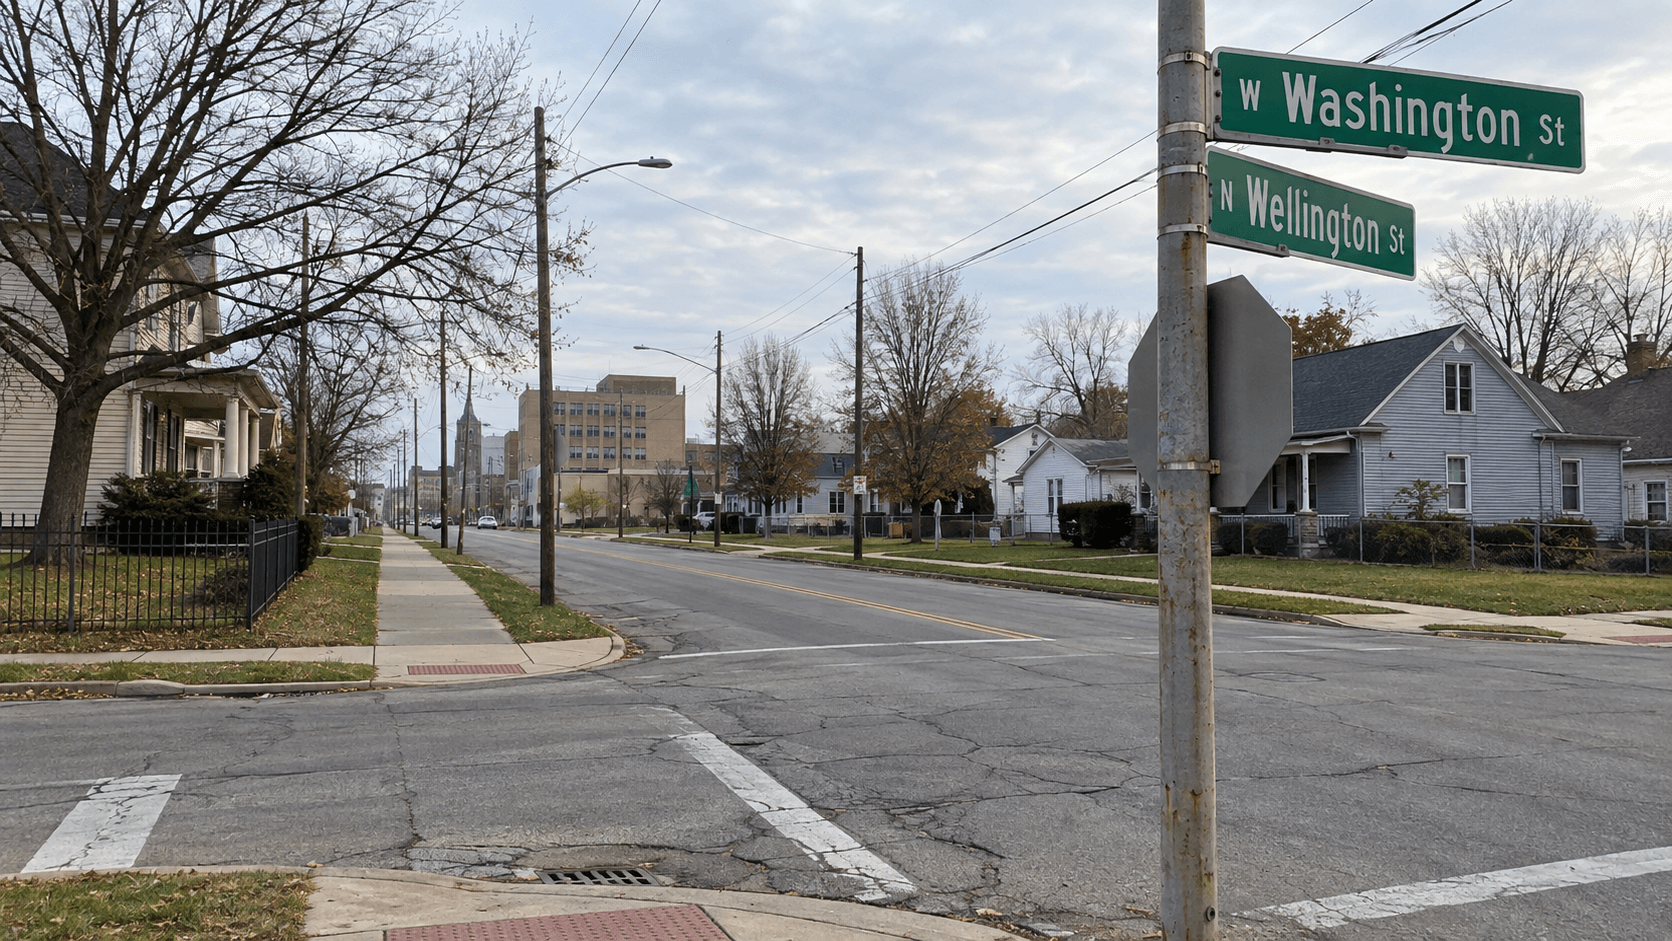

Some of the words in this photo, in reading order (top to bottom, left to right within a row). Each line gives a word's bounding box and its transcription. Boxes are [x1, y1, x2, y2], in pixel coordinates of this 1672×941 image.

[1239, 78, 1261, 111] W
[1282, 71, 1520, 154] Washington
[1538, 113, 1565, 147] St
[1220, 179, 1233, 212] N
[1246, 174, 1380, 259] Wellington
[1389, 224, 1405, 256] St
